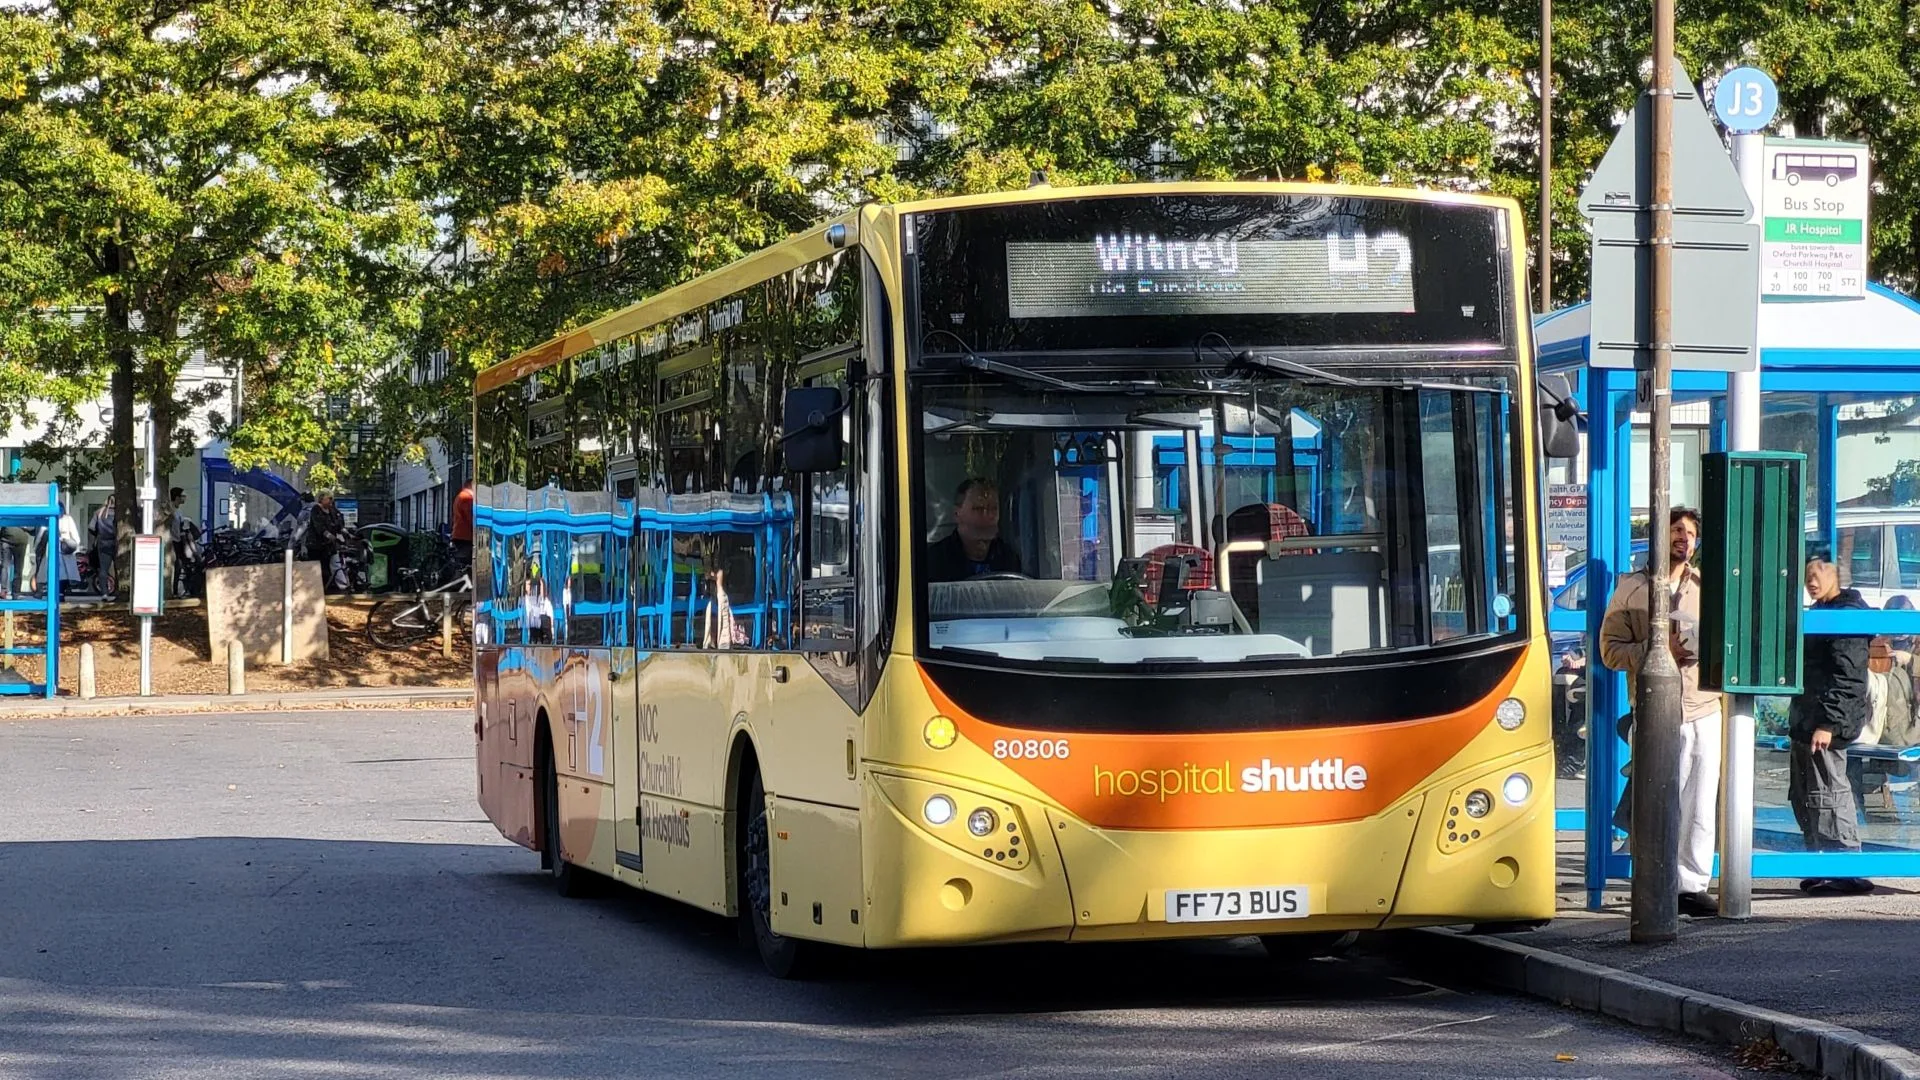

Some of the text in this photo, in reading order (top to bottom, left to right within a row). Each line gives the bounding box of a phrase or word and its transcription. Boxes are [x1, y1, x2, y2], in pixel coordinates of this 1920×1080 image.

[1727, 81, 1763, 116] J3
[1784, 197, 1845, 216] Bus Stop
[1784, 221, 1842, 237] JR Hospital
[1095, 232, 1240, 276] Witney
[1772, 250, 1797, 258] Oxford
[1798, 251, 1828, 259] Parkway
[1829, 251, 1844, 259] P&R
[1814, 260, 1843, 268] Hospital
[1773, 271, 1779, 279] 4
[1793, 271, 1808, 280] 100
[1817, 271, 1833, 280] 700
[1770, 283, 1781, 292] 20
[1793, 283, 1808, 292] 600
[1818, 283, 1831, 292] H2
[1841, 278, 1857, 287] ST2
[640, 704, 659, 744] NOC
[993, 739, 1069, 759] 80806
[640, 752, 683, 797] Churchill &
[1093, 758, 1368, 802] hospital shuttle
[1175, 889, 1297, 917] FF73 BUS
